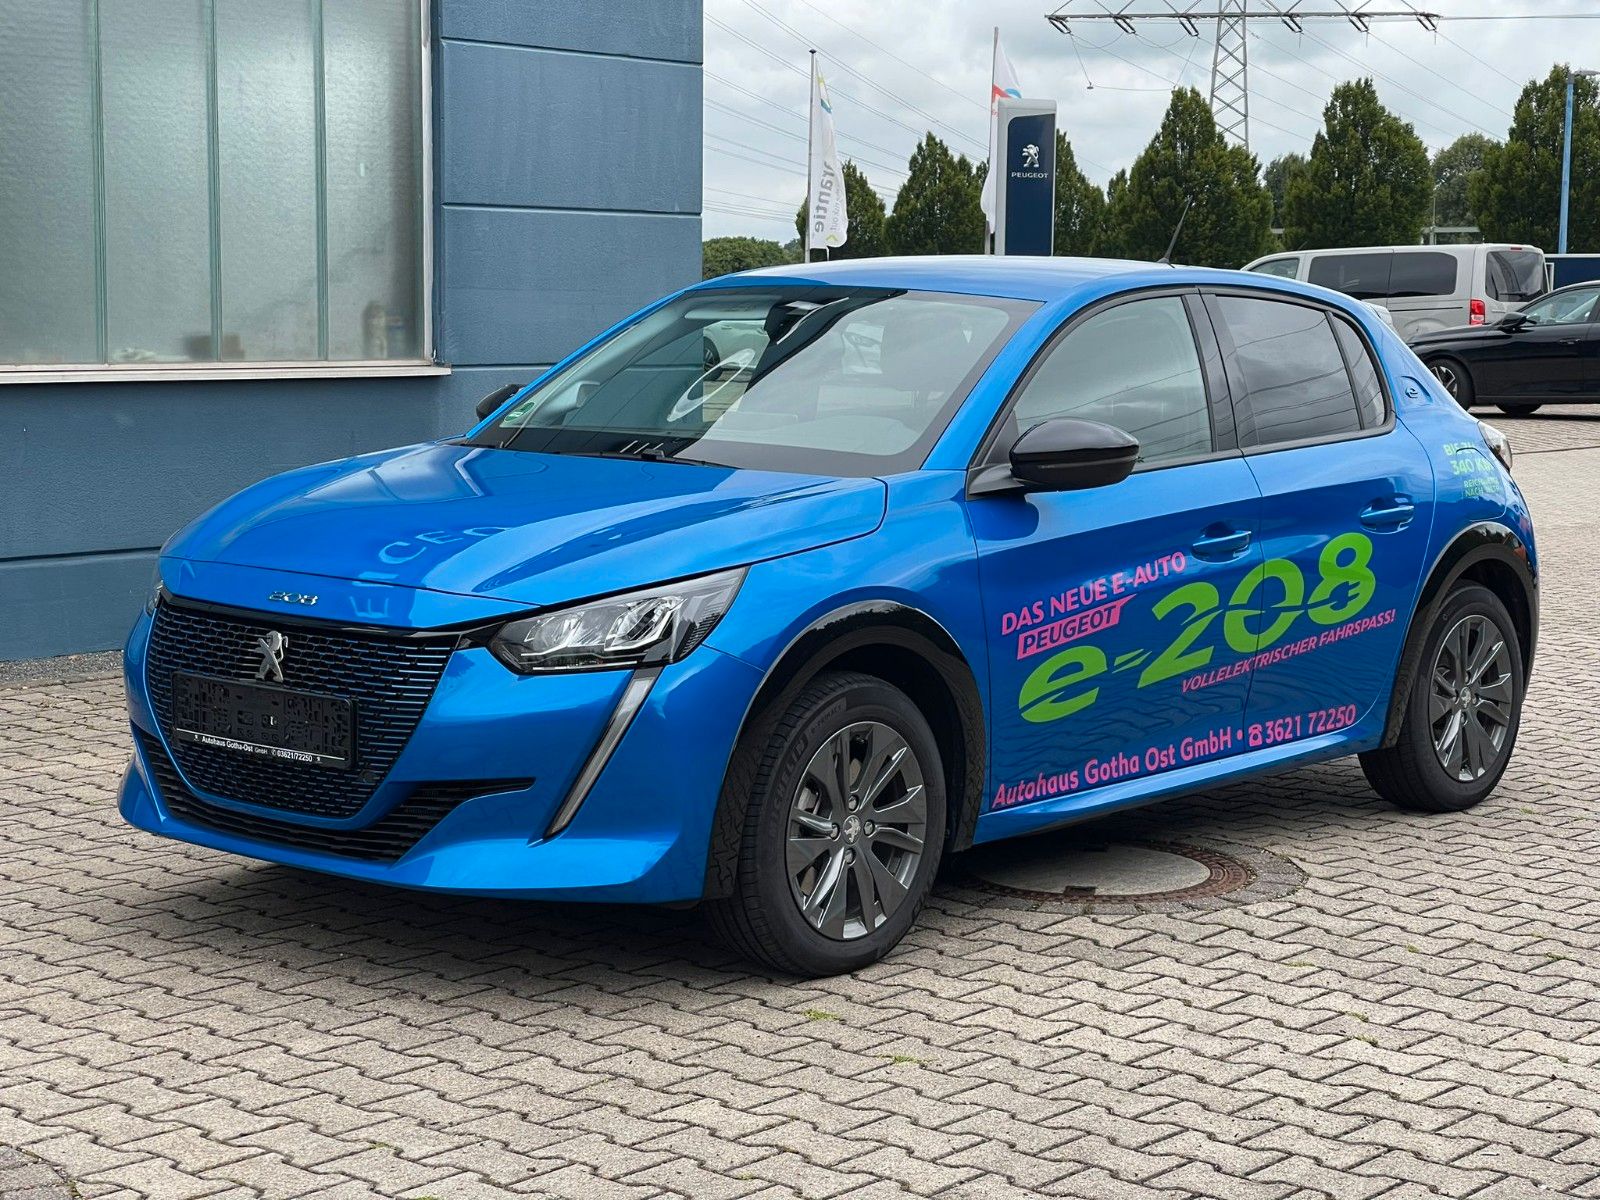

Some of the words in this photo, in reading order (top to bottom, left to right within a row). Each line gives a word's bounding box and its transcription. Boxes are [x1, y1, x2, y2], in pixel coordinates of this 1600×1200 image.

[1011, 171, 1048, 179] PEUGEOT
[1450, 459, 1475, 476] 340
[269, 590, 318, 606] 208
[1001, 600, 1045, 636] DAS
[1050, 578, 1108, 618] NEUE
[1112, 551, 1186, 595] E-AUTO
[1018, 532, 1376, 723] e-208
[1022, 605, 1117, 654] PEUGEOT
[1181, 636, 1317, 693] VOLLELEKTRISCHER
[1319, 609, 1396, 647] FAHRSPASS!
[202, 736, 226, 747] Autohaus
[227, 741, 254, 752] Gotha-Ost
[992, 772, 1079, 808] Autohaus
[1084, 752, 1140, 784] Gotha
[1145, 744, 1176, 771] Ost
[1180, 727, 1232, 761] GmbH
[1308, 704, 1357, 735] 72250
